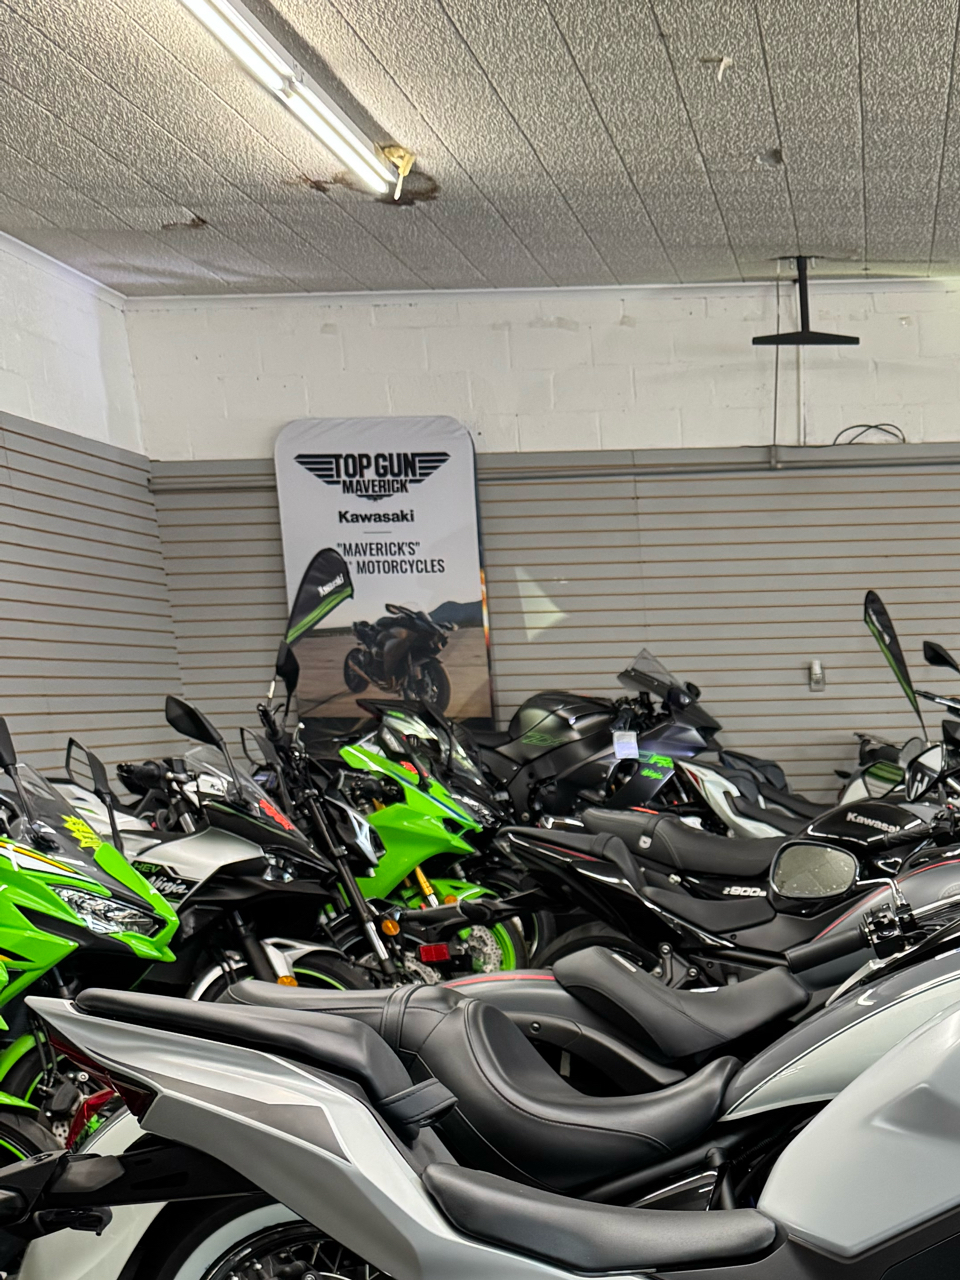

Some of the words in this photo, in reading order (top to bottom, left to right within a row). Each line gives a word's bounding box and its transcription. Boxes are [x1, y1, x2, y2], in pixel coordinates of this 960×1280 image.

[333, 453, 371, 479] TOP
[374, 452, 418, 478] GUN
[342, 479, 409, 494] MAVERICK
[338, 509, 415, 524] Kawasaki
[337, 541, 421, 557] "MAVERICK'S"
[356, 559, 446, 575] MOTORCYCLES
[846, 811, 900, 833] Kawasa
[147, 874, 189, 895] Ninja
